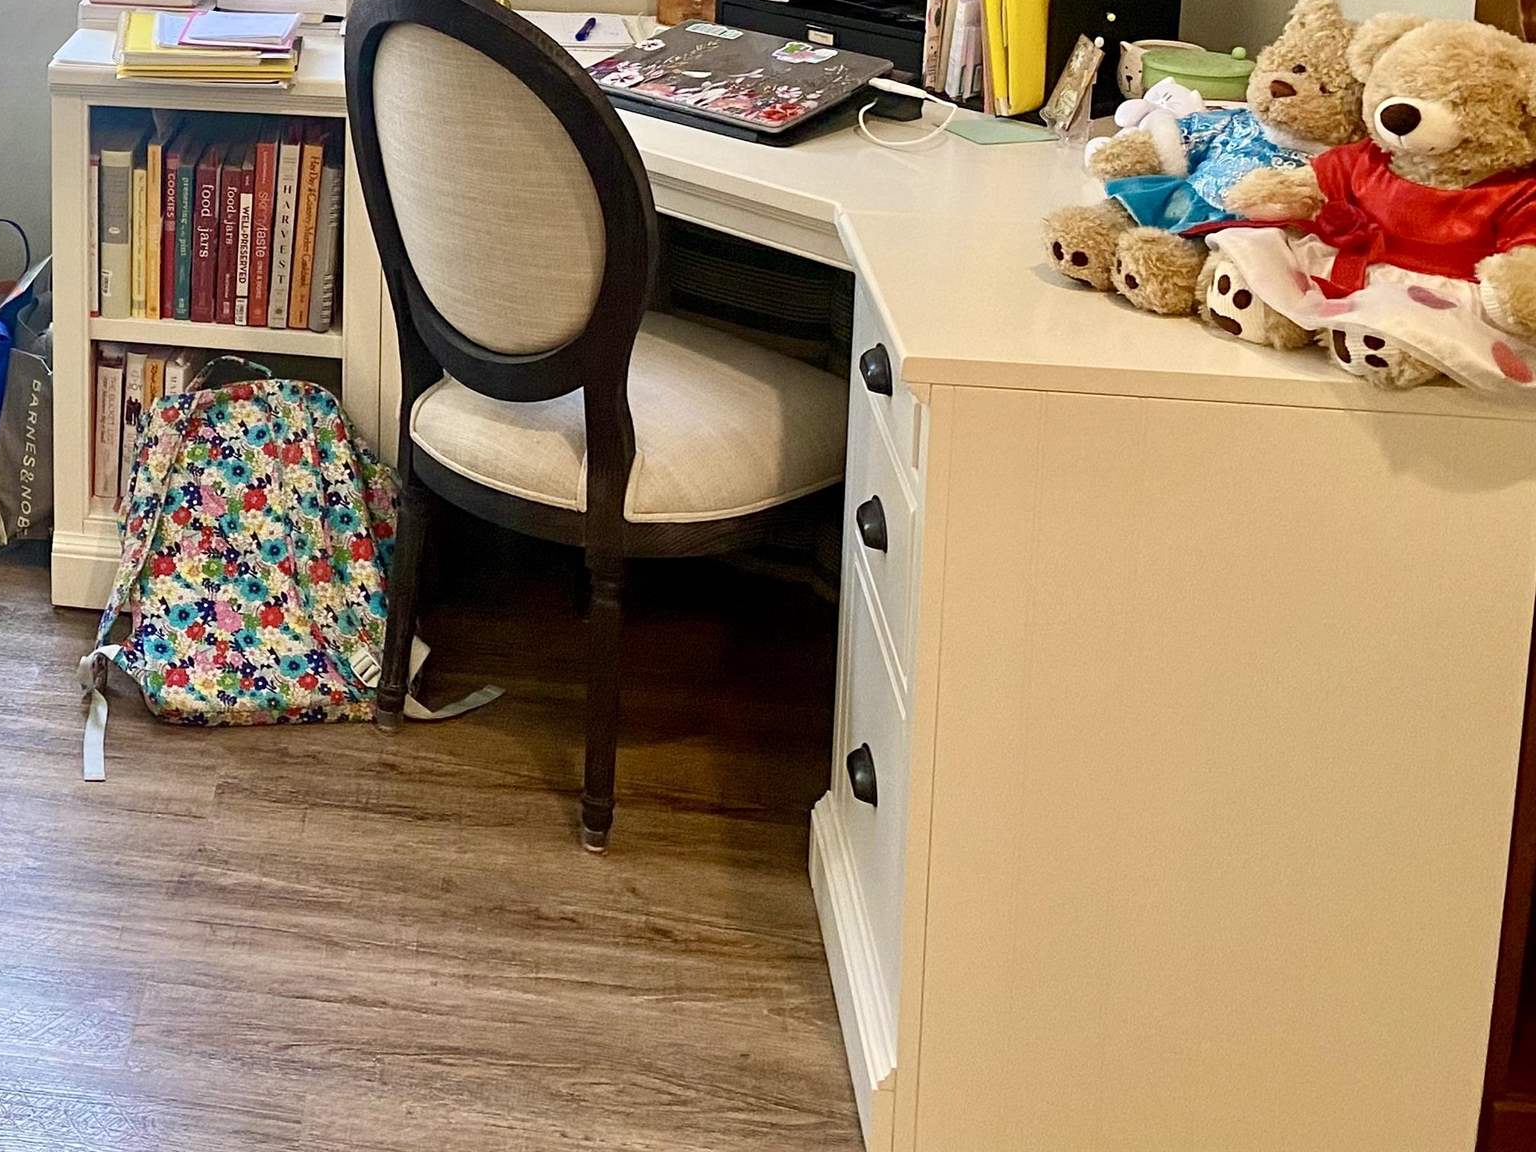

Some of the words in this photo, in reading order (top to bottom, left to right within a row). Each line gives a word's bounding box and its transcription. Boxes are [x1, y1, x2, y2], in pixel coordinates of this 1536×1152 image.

[166, 173, 175, 218] COOKIES
[180, 177, 190, 224] preserving
[201, 184, 214, 217] food
[226, 186, 238, 213] food
[197, 225, 212, 258] jars
[224, 220, 236, 245] jars
[239, 206, 250, 284] WELL-PRESERVED
[277, 184, 292, 285] HARVEST
[17, 379, 42, 535] BARNES&NOB
